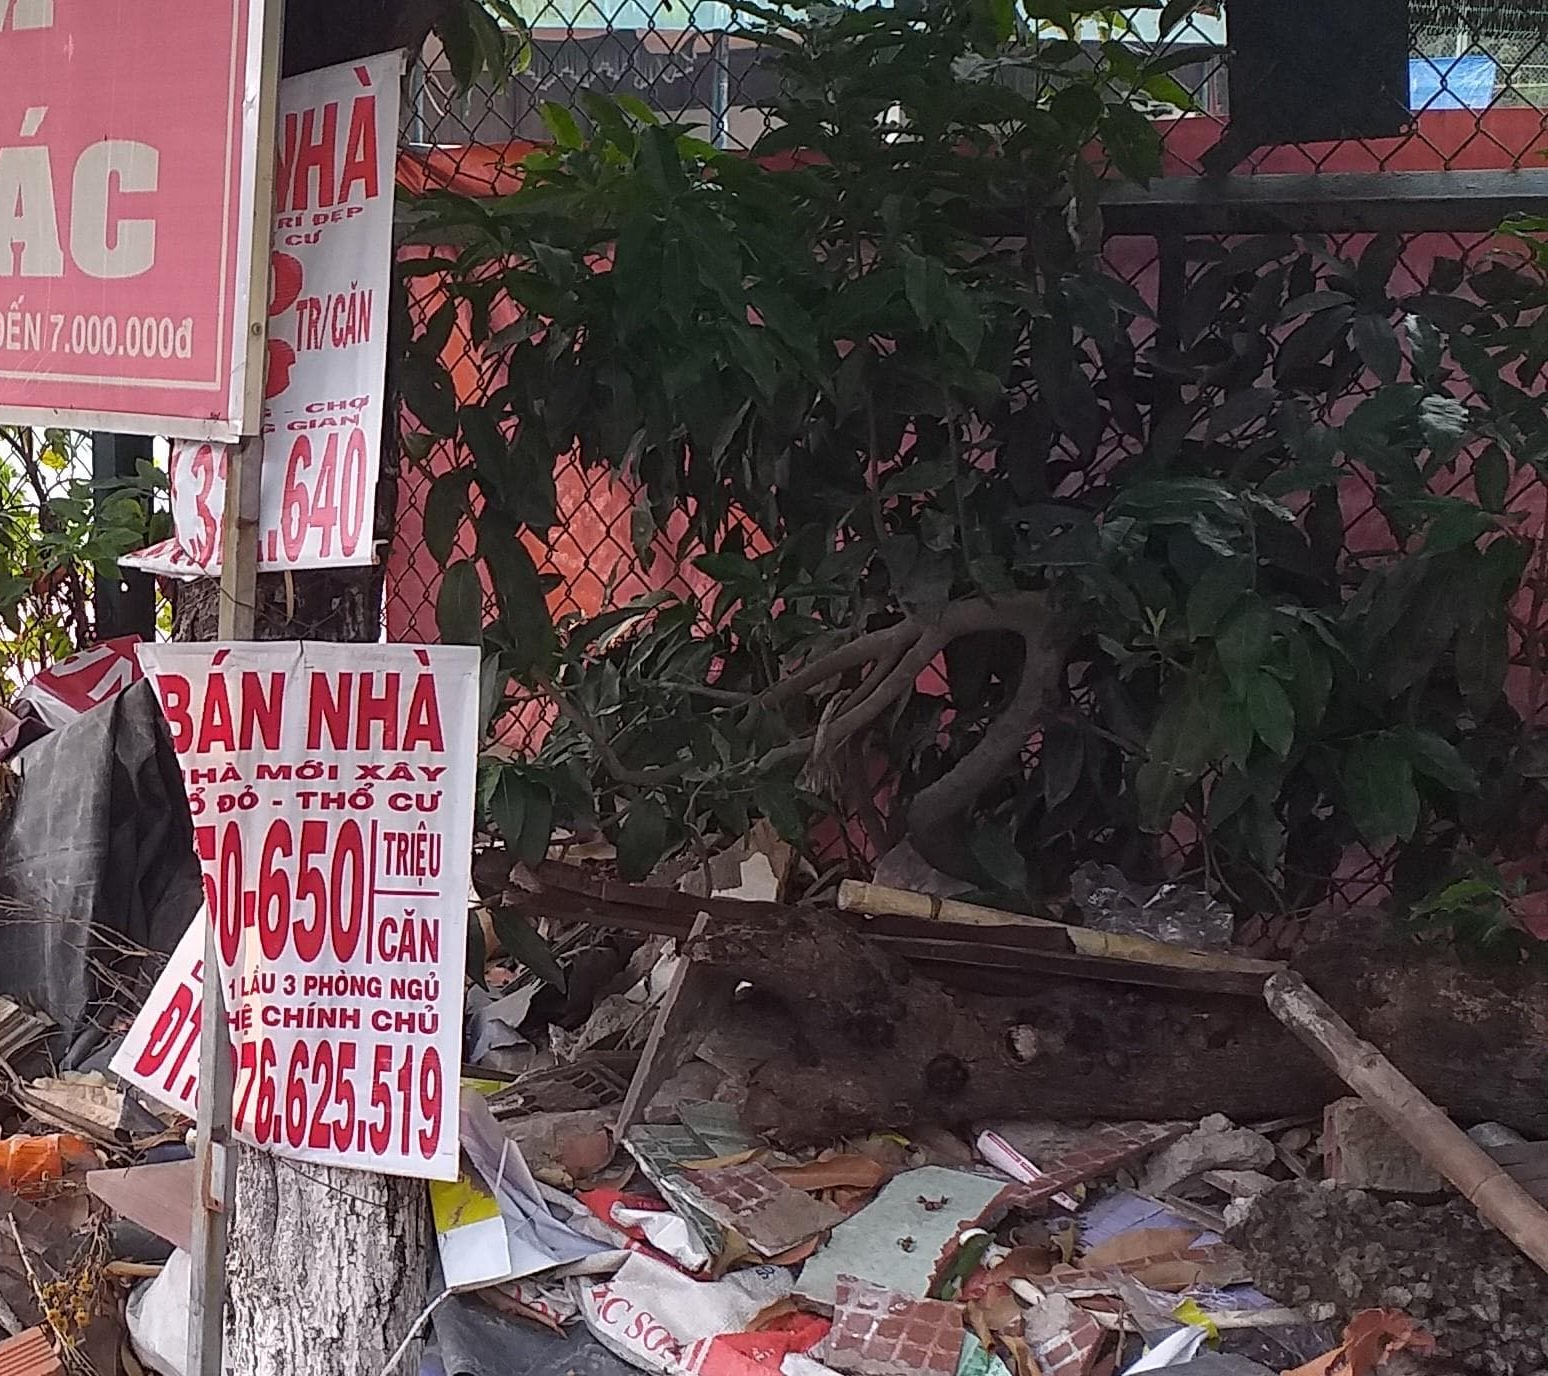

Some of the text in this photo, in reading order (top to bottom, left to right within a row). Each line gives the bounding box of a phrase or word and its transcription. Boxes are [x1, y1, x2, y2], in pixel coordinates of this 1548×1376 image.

[312, 207, 364, 226] ĐẸP
[285, 229, 322, 247] CƯ
[295, 280, 374, 353] TR/CĂN
[49, 313, 194, 359] 7.000.000đ
[305, 394, 370, 414] CHỢ
[287, 414, 360, 431] GIAN
[156, 649, 286, 754] BÁN
[307, 649, 445, 753] NHÀ
[182, 759, 448, 785] HÀ MỚI XÂY
[217, 784, 260, 814] ĐỎ
[295, 781, 375, 812] THỔ
[387, 788, 443, 812] CƯ
[382, 820, 442, 887] TRIỆU
[378, 908, 440, 965] CĂN
[228, 963, 441, 1001] 1 LẦU 3 PHÒNG NGỦ
[260, 1000, 361, 1031] CHÍNH
[370, 1004, 441, 1035] CHỦ
[229, 1036, 443, 1160] 76.625.519
